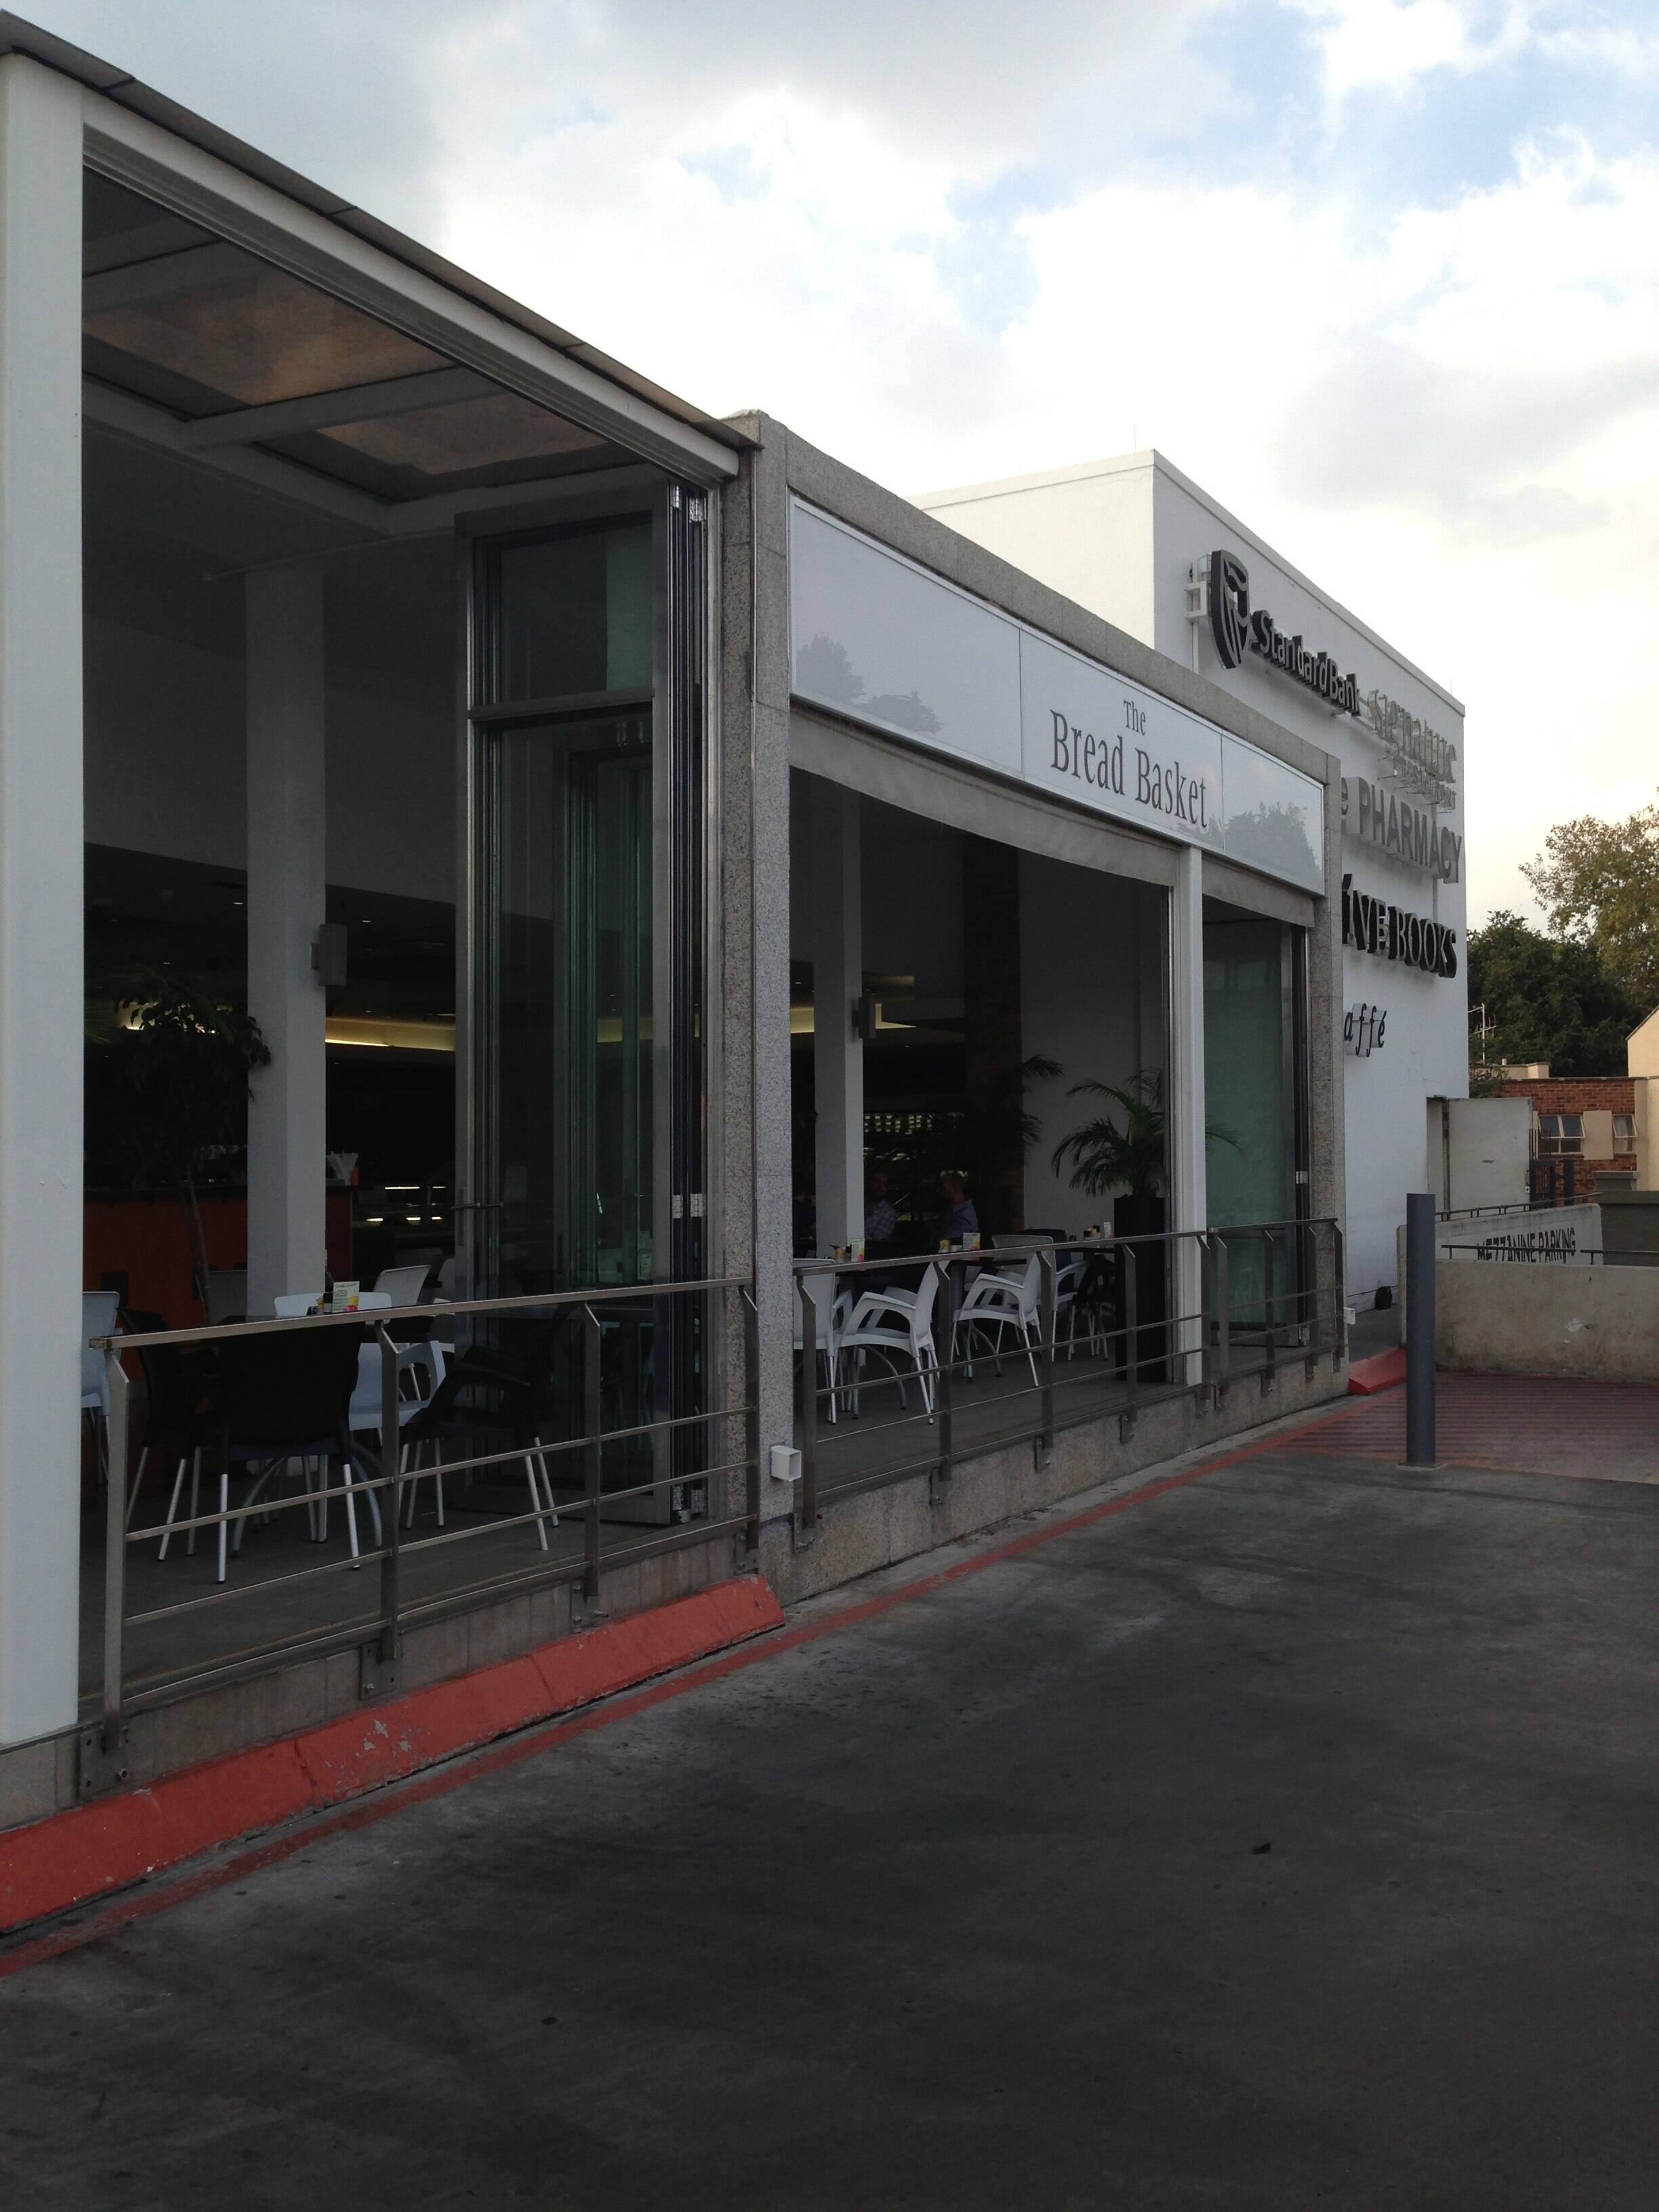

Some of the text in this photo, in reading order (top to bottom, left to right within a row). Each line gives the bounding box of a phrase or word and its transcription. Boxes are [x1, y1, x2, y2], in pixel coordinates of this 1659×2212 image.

[1124, 699, 1146, 735] The
[1050, 710, 1207, 828] Bread Basket
[1358, 777, 1462, 884] PHARMACY
[1388, 906, 1457, 978] BOOKS
[1344, 1003, 1387, 1057] affé
[1538, 1227, 1576, 1263] PARKING
